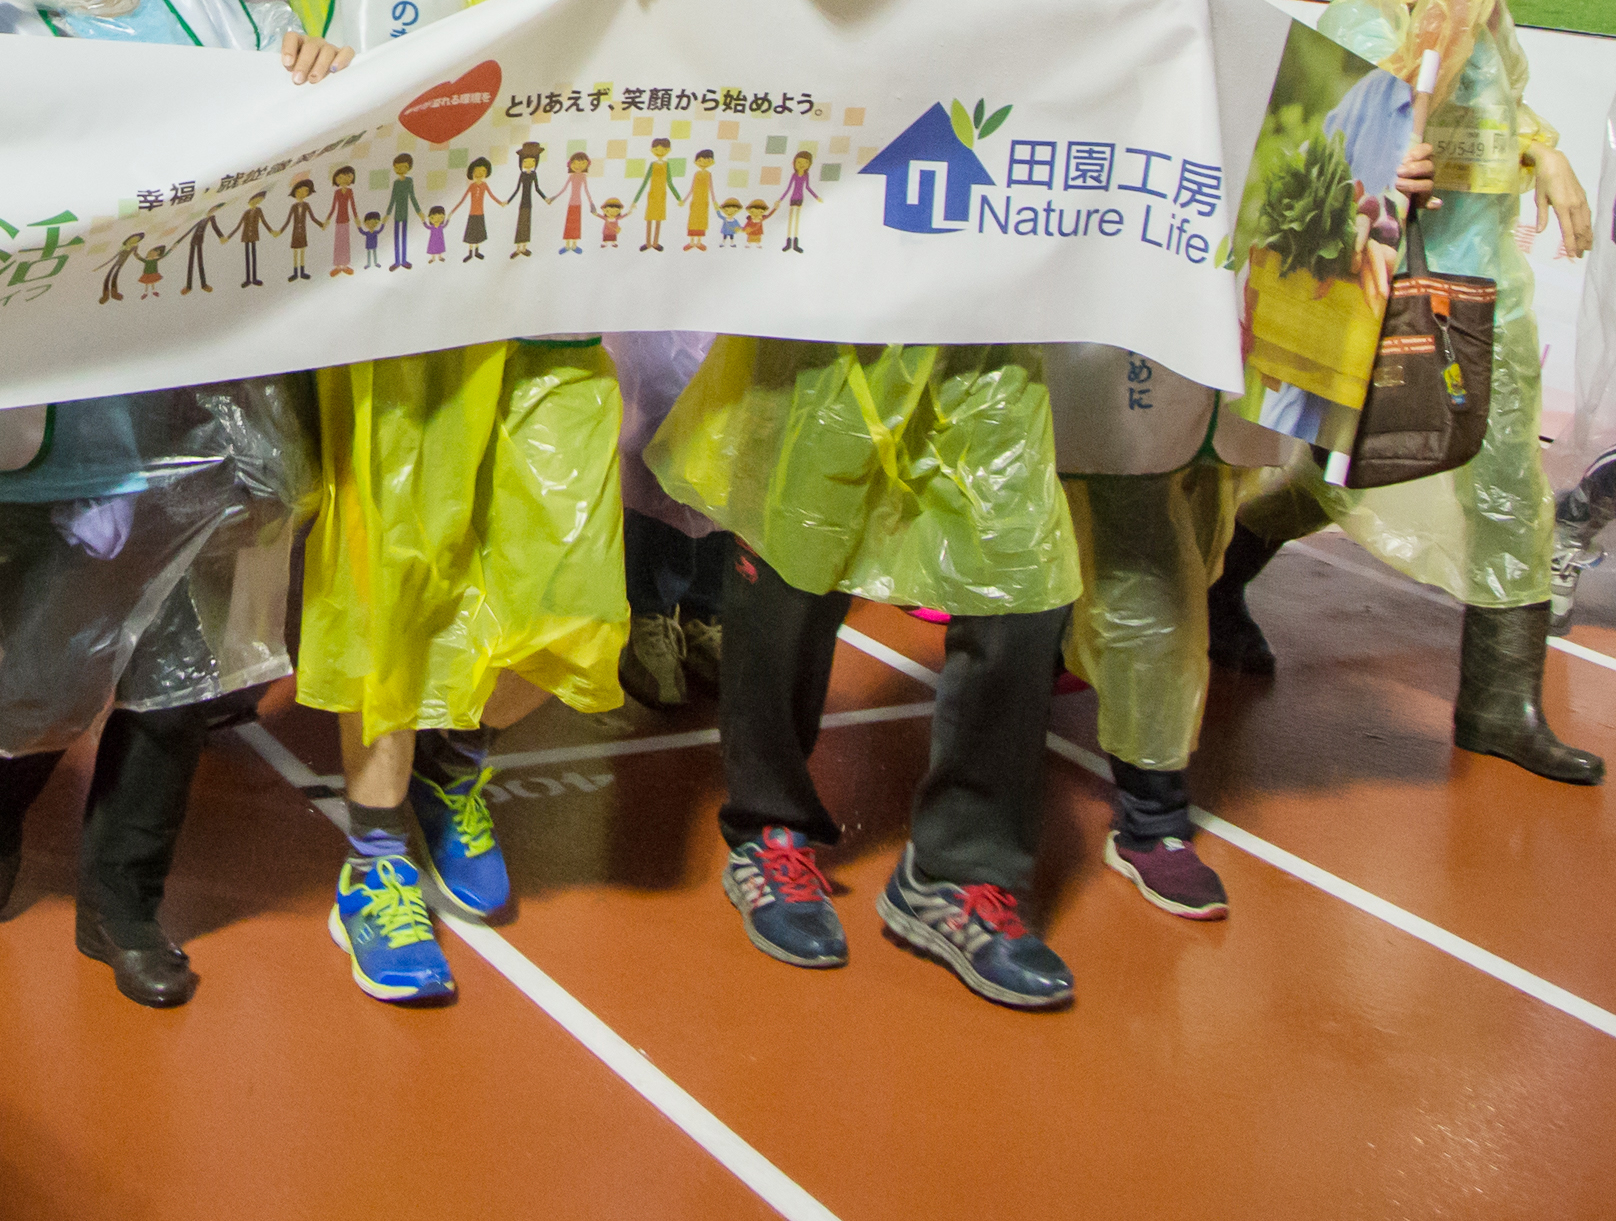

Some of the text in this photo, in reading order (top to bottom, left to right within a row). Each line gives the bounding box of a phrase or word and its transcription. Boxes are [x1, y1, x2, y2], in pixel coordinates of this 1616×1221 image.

[505, 87, 824, 118] とりあえず、笑顔から始めよう。
[1005, 139, 1224, 219] 田園工房
[978, 194, 1211, 265] Nature Life
